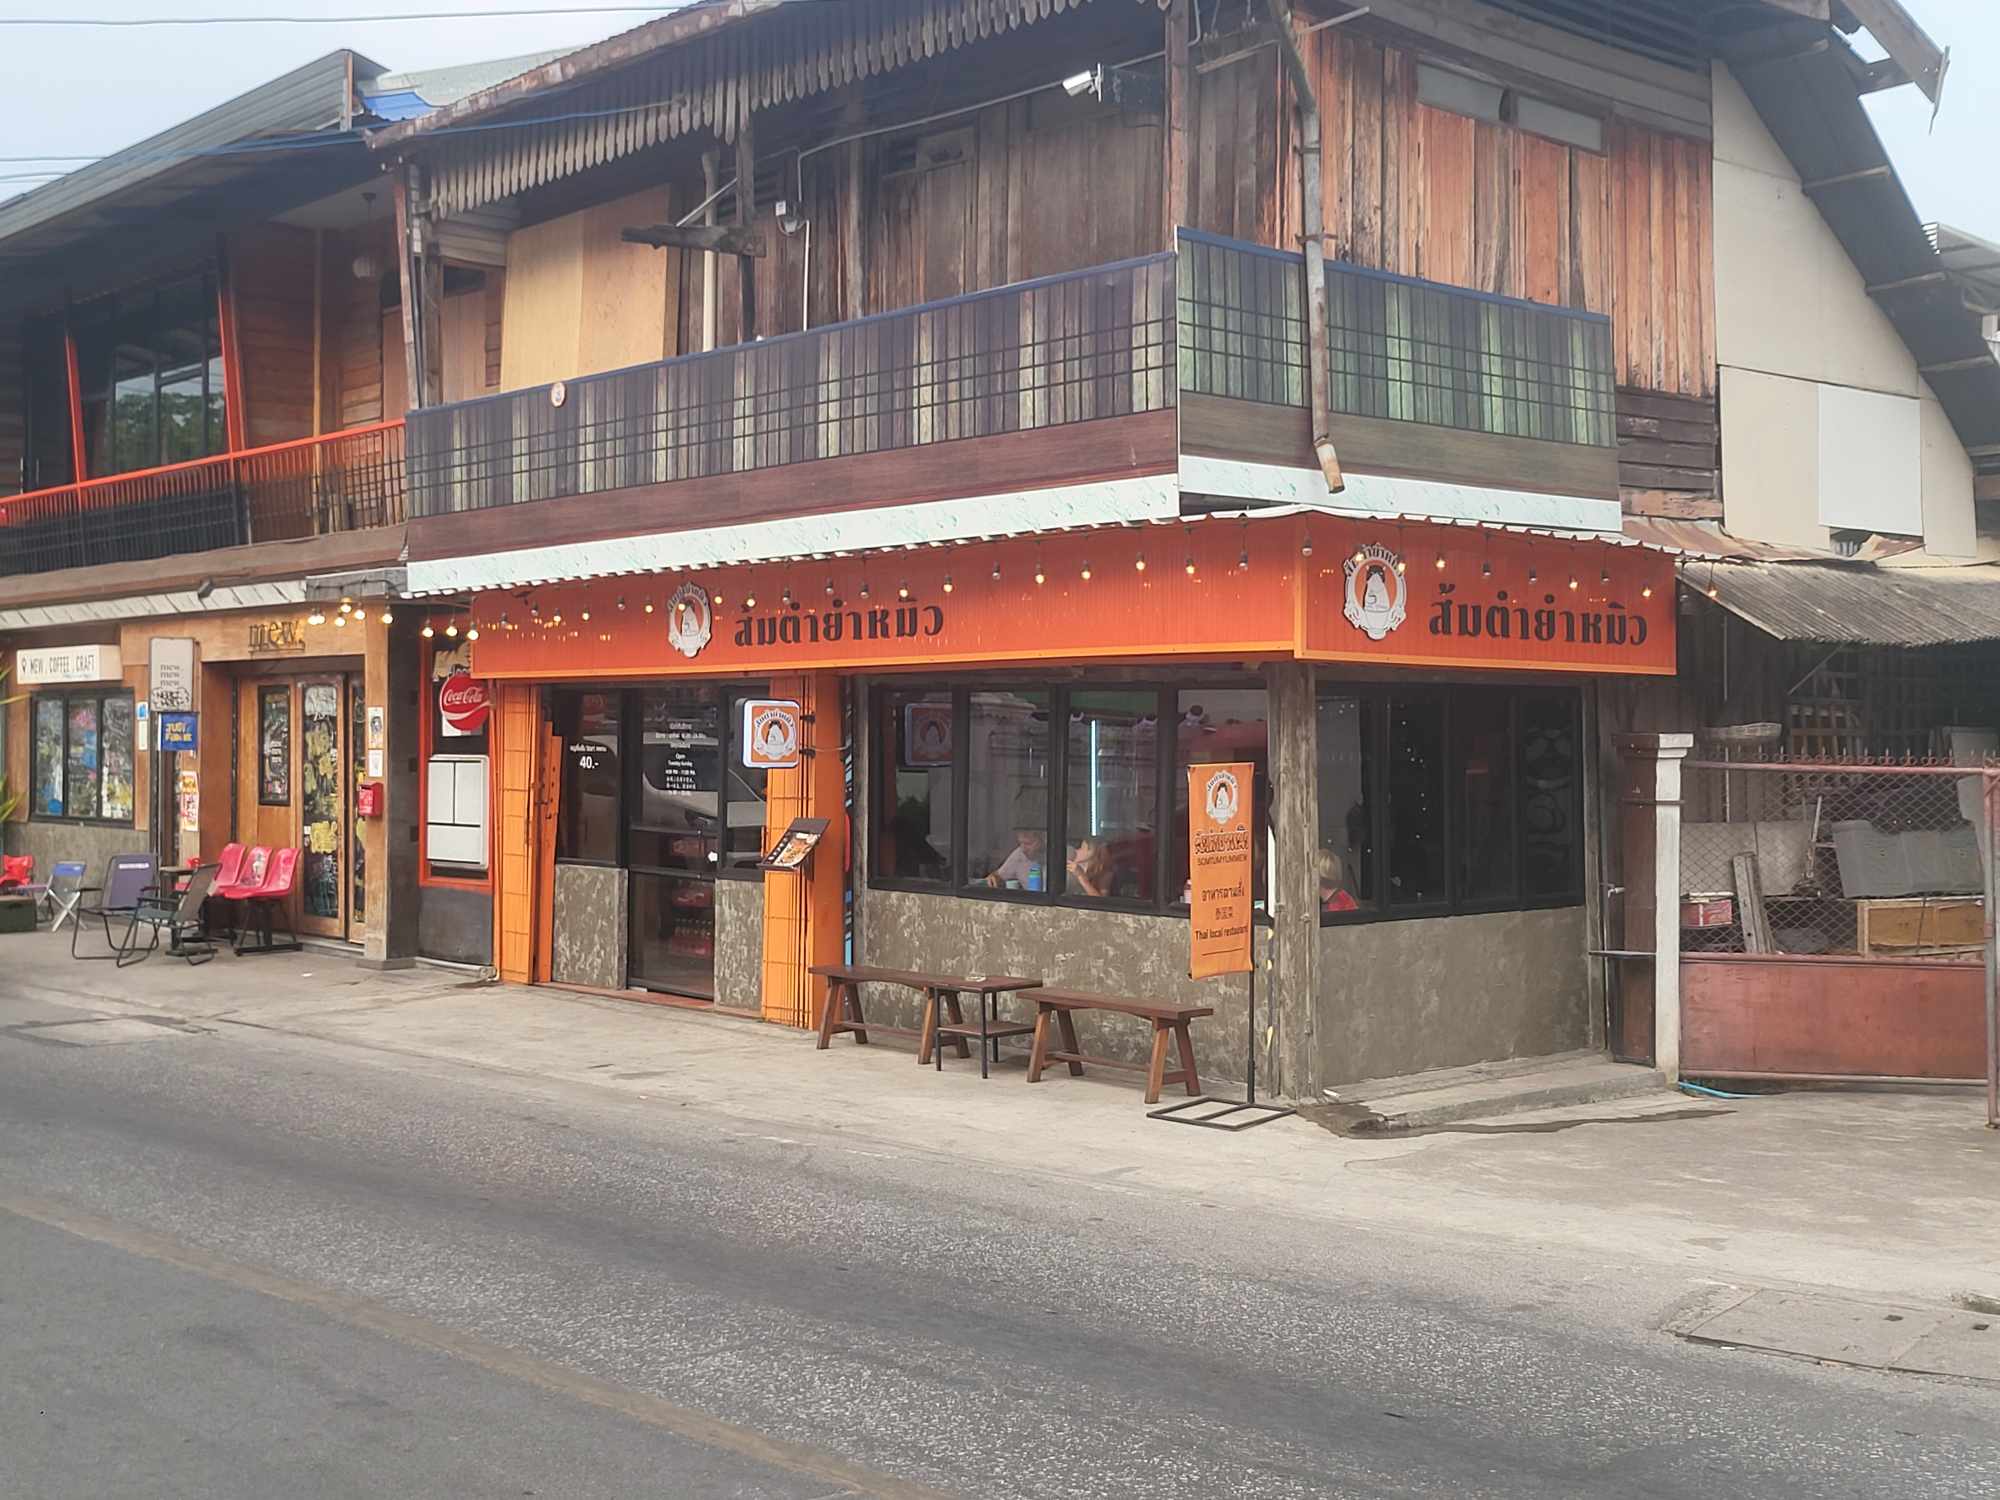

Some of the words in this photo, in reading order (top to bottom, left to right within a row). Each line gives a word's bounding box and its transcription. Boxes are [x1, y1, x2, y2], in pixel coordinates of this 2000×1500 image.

[734, 596, 944, 647] ส้มตำยำหมิว
[1429, 583, 1648, 645] ส้มตำยำหมิว
[580, 755, 599, 769] 40.-
[1195, 928, 1209, 940] Thai
